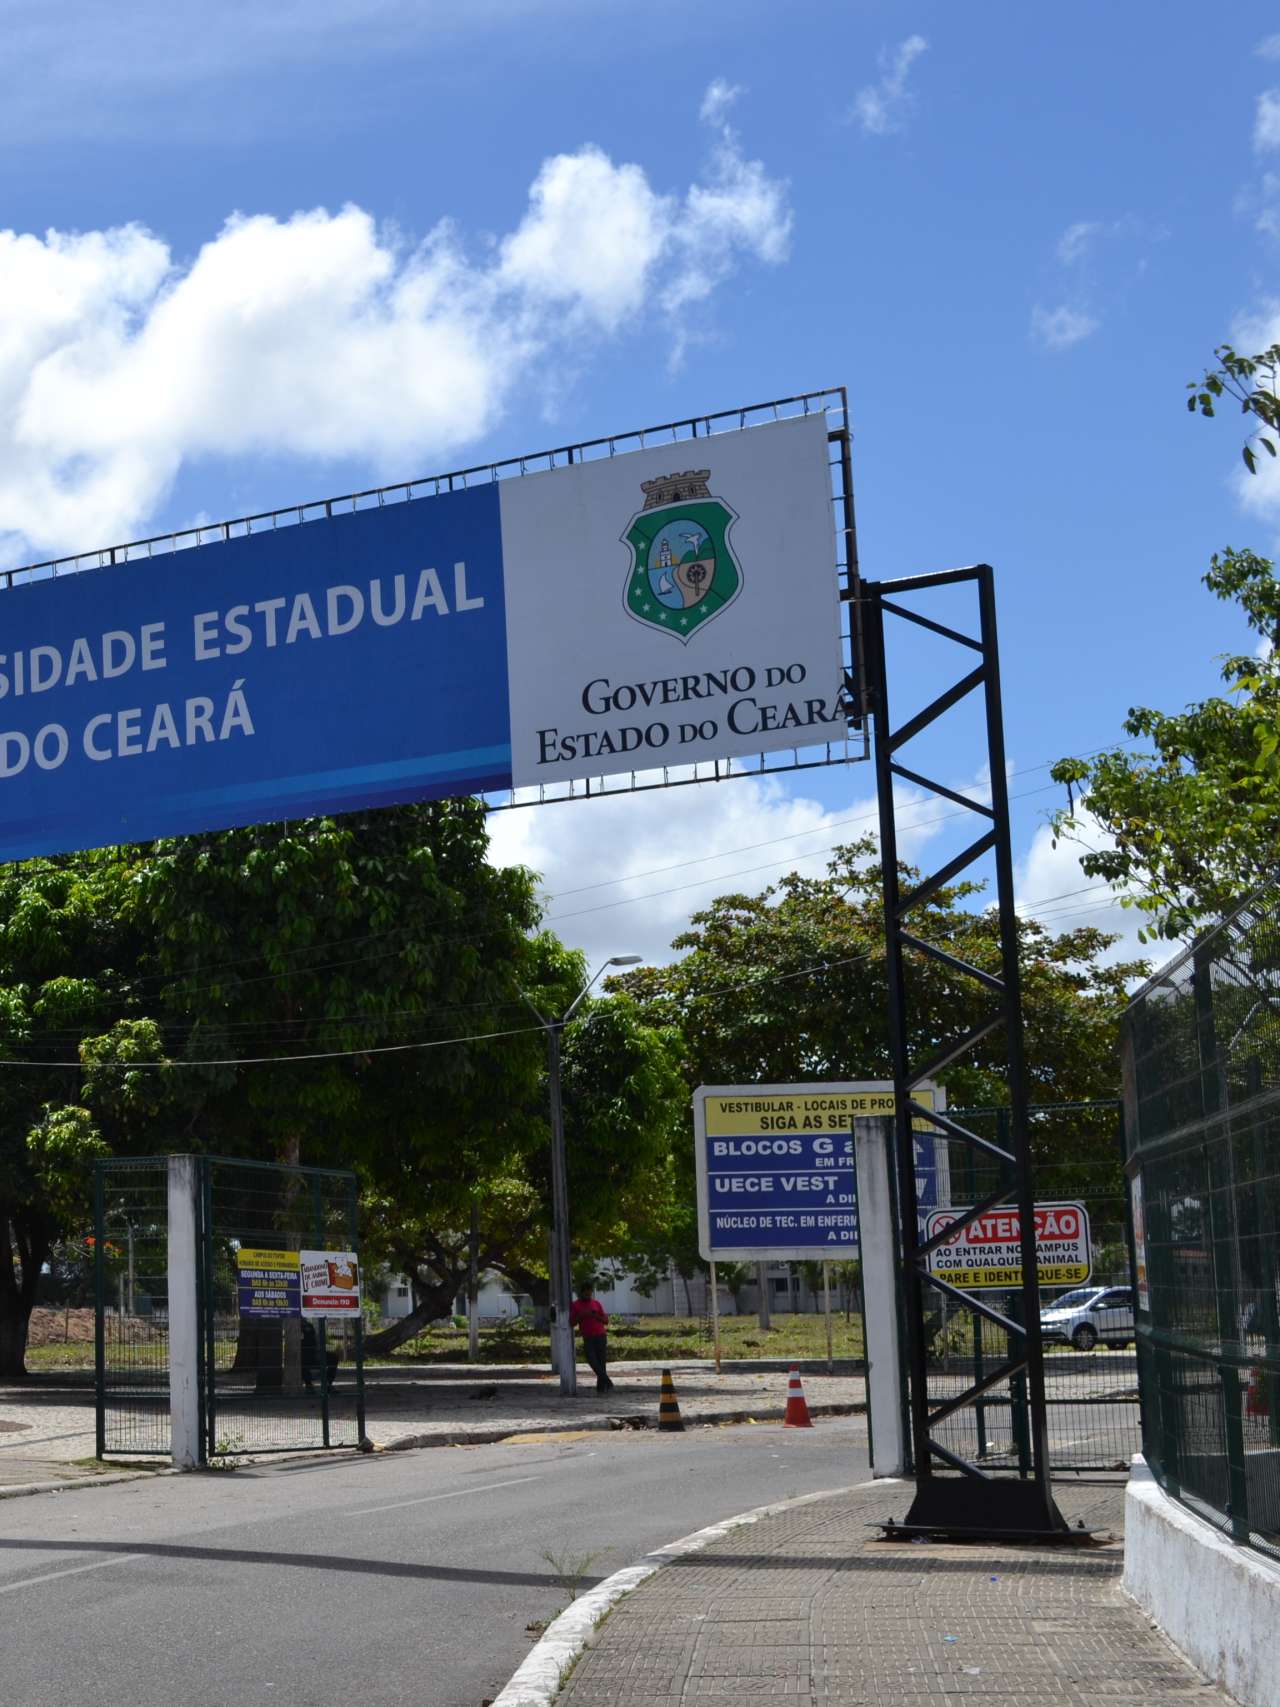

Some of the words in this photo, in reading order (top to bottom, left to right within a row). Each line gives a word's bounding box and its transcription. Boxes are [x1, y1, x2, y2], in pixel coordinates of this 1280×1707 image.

[194, 562, 484, 661] ESTADUAL
[582, 666, 756, 715] GOVERNO
[766, 664, 807, 688] DO
[82, 679, 255, 762] CEARÁ
[536, 722, 669, 764] ESTADO
[679, 720, 718, 744] DO
[720, 1102, 794, 1113] VESTIBULAR
[804, 1101, 848, 1112] LOCAIS
[851, 1099, 866, 1110] DE
[760, 1116, 796, 1130] SIGA
[803, 1115, 824, 1129] AS
[828, 1114, 854, 1128] SET
[714, 1141, 802, 1156] BLOCOS
[812, 1138, 834, 1154] G
[815, 1158, 835, 1167] EM
[715, 1177, 774, 1192] UECE
[780, 1176, 839, 1191] VEST
[826, 1195, 835, 1204] A
[716, 1214, 757, 1229] NÚCLEO
[759, 1217, 773, 1228] DE
[775, 1216, 798, 1228] TEC.
[800, 1216, 815, 1227] EM
[827, 1231, 837, 1241] A
[936, 1248, 952, 1257] AO
[955, 1246, 1002, 1257] ENTRAR
[1006, 1244, 1022, 1254] NO
[1036, 1242, 1079, 1253] AMPUS
[936, 1259, 962, 1269] COM
[966, 1256, 1023, 1268] QUALQUE
[1035, 1254, 1082, 1265] ANIMAL
[939, 1272, 969, 1284] PARE
[974, 1272, 981, 1282] E
